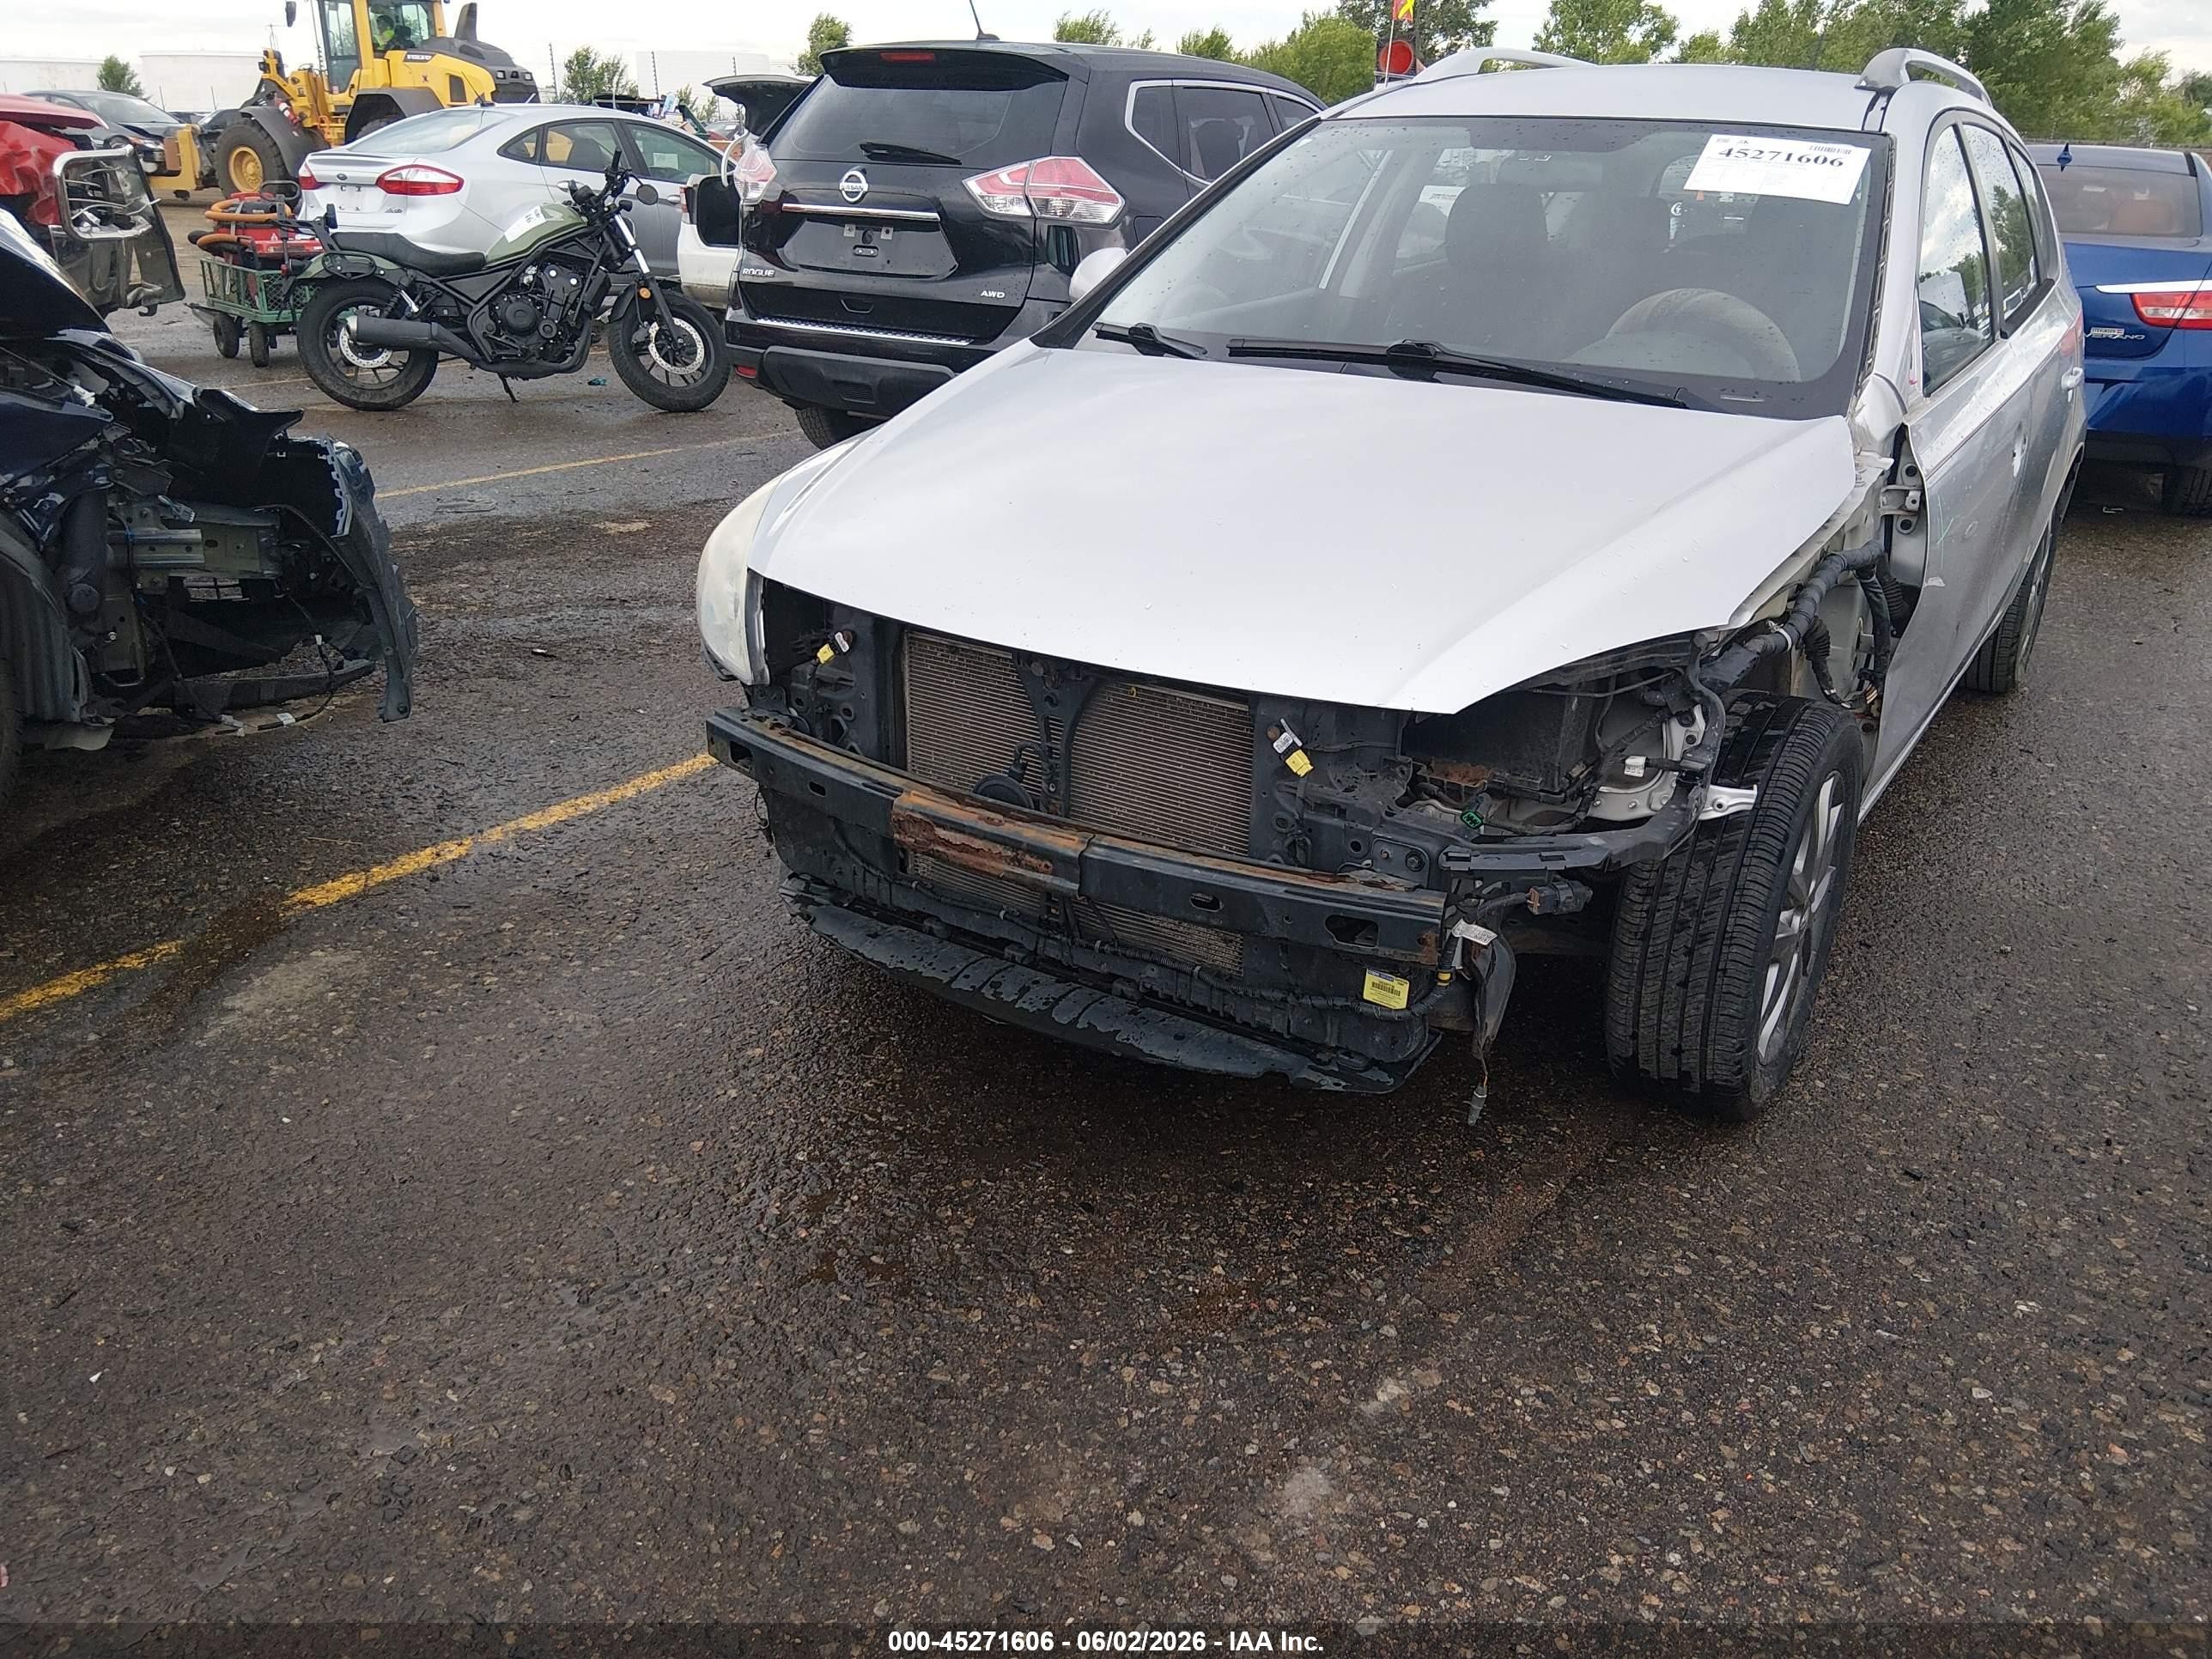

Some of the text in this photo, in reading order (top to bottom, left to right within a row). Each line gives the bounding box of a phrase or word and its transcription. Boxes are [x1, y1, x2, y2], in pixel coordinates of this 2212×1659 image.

[1718, 147, 1844, 167] 45271606
[743, 267, 775, 277] ROGUE
[981, 290, 1006, 299] AWD
